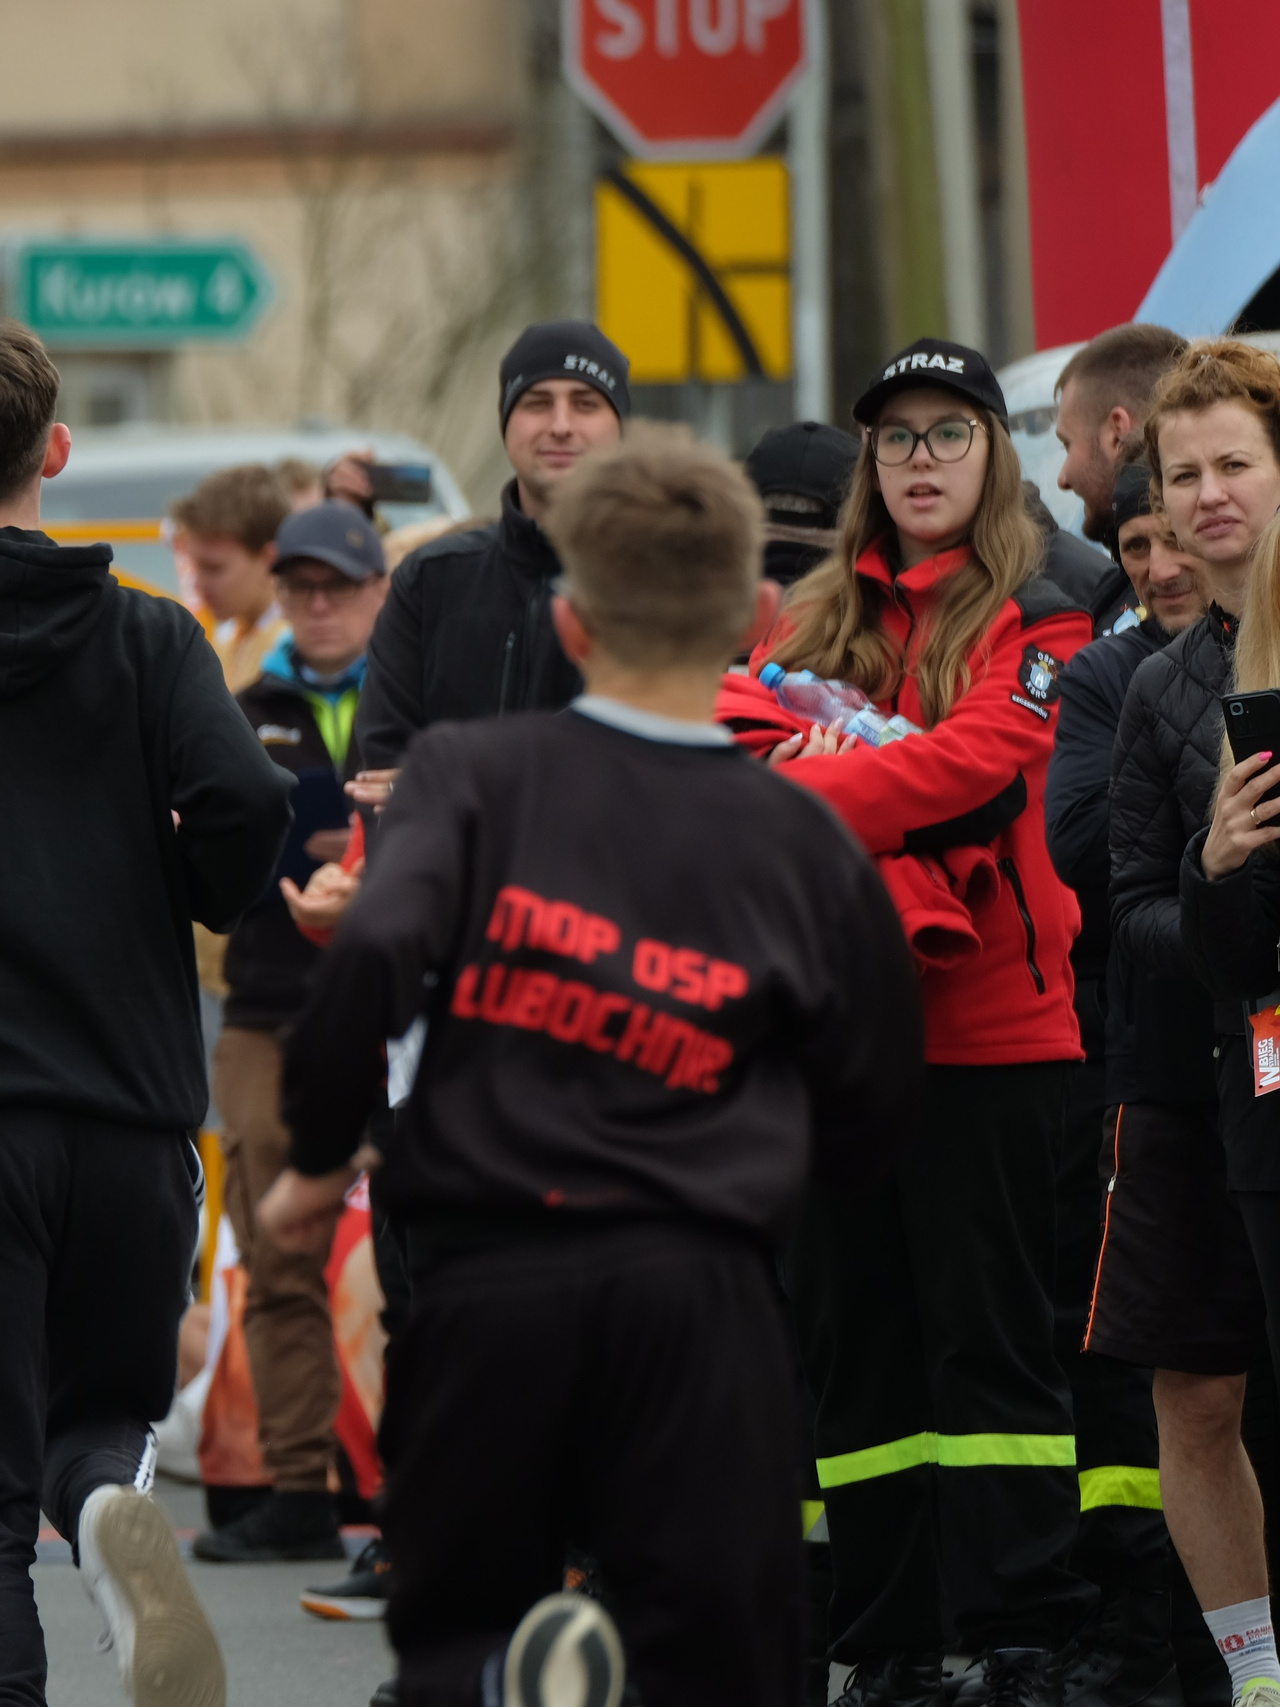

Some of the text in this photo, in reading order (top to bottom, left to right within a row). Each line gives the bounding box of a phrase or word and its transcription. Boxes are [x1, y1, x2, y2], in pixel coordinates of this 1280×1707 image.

[594, 0, 792, 61] STOP
[631, 937, 750, 1013] OSP
[1258, 1038, 1269, 1067] BIEG
